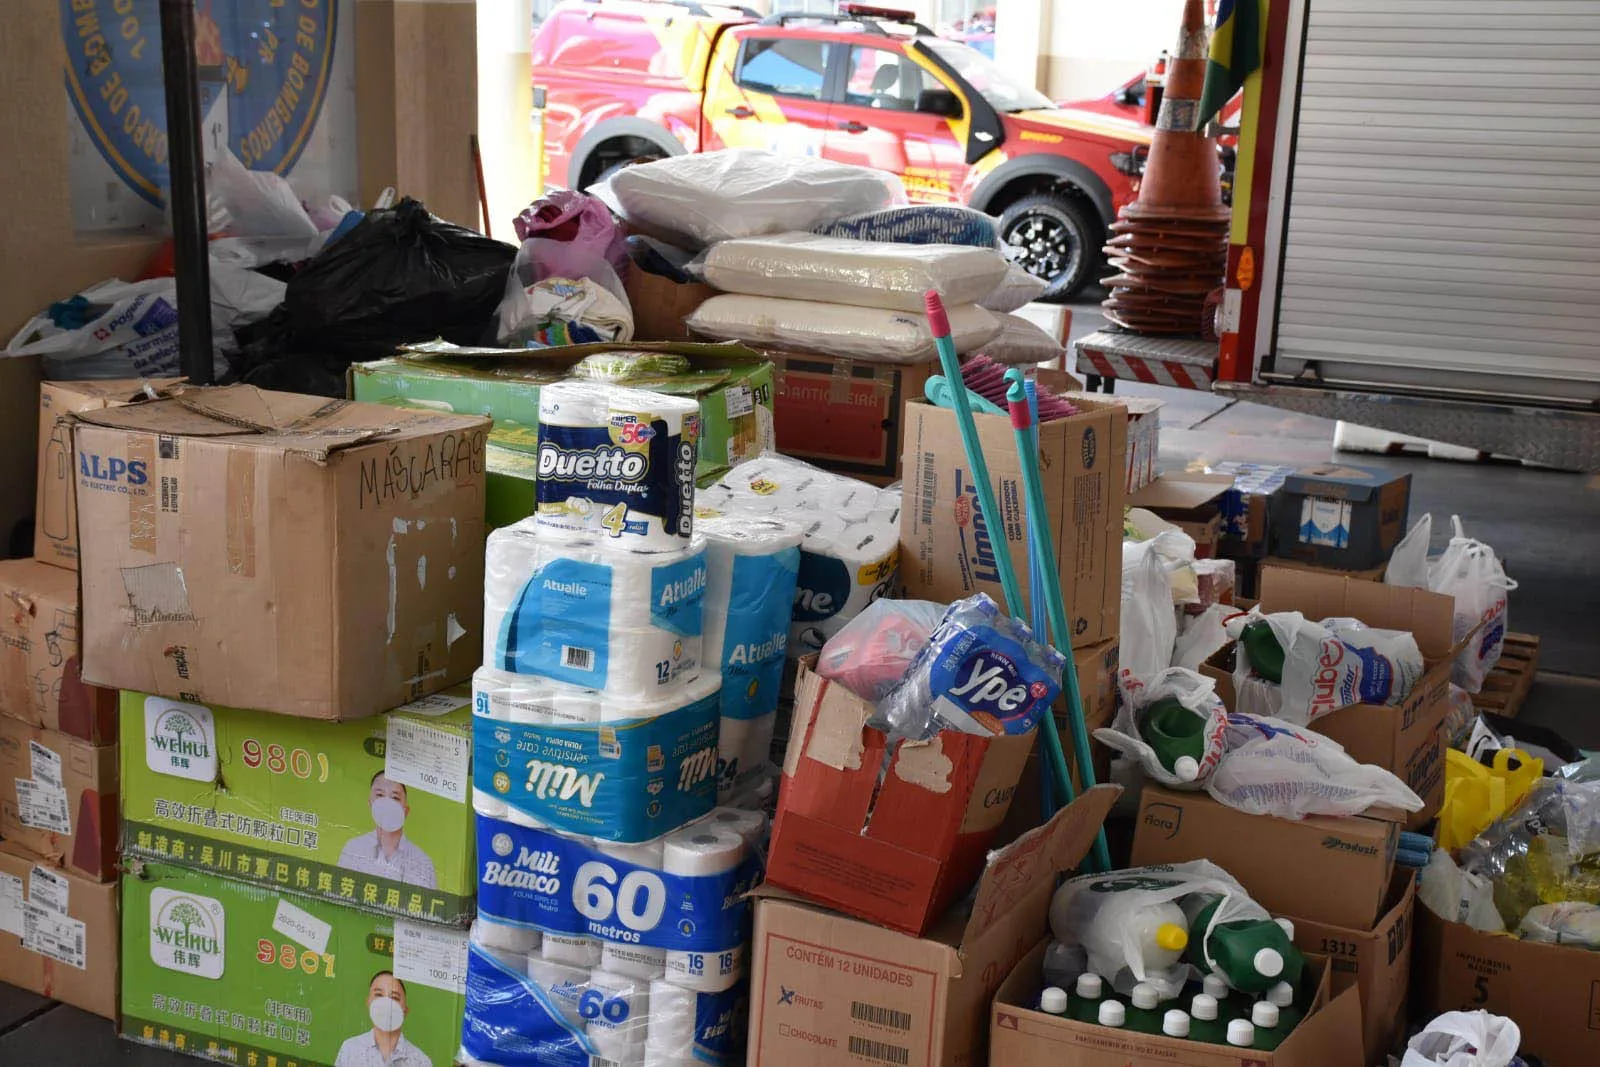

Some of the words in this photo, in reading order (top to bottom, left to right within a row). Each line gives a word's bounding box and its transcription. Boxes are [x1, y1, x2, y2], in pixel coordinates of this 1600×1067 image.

[241, 52, 311, 168] BOMBEIROS
[360, 430, 483, 509] MÁSCARAS
[538, 444, 645, 479] Duetto
[587, 480, 614, 492] Folha
[614, 481, 645, 494] Dupla
[676, 442, 693, 536] Duetto
[602, 502, 628, 537] 4
[542, 579, 588, 596] Atualle
[729, 632, 787, 665] Atualle
[656, 660, 670, 679] 12
[476, 697, 490, 714] 16
[516, 740, 539, 755] care
[542, 746, 589, 764] sensitive
[420, 772, 439, 786] 1000
[442, 779, 457, 792] PCS
[524, 760, 606, 808] Mili
[154, 799, 320, 850] 高效折叠式防颗粒口罩
[1144, 815, 1174, 830] flora
[514, 846, 560, 876] Mili
[482, 861, 560, 895] Bianco
[572, 861, 666, 932] 60
[588, 921, 641, 944] metros
[1320, 937, 1358, 957] 1312
[172, 949, 201, 969] 伟辉
[688, 953, 703, 969] 16
[719, 953, 733, 969] 16
[786, 946, 834, 969] CONTÉM
[837, 959, 850, 972] 12
[852, 963, 914, 988] UNIDADES
[429, 968, 448, 981] 1000
[1472, 975, 1490, 1003] 5
[577, 988, 631, 1023] 60
[795, 994, 824, 1010] FRUTAS
[789, 1027, 838, 1048] CHOCOLATE
